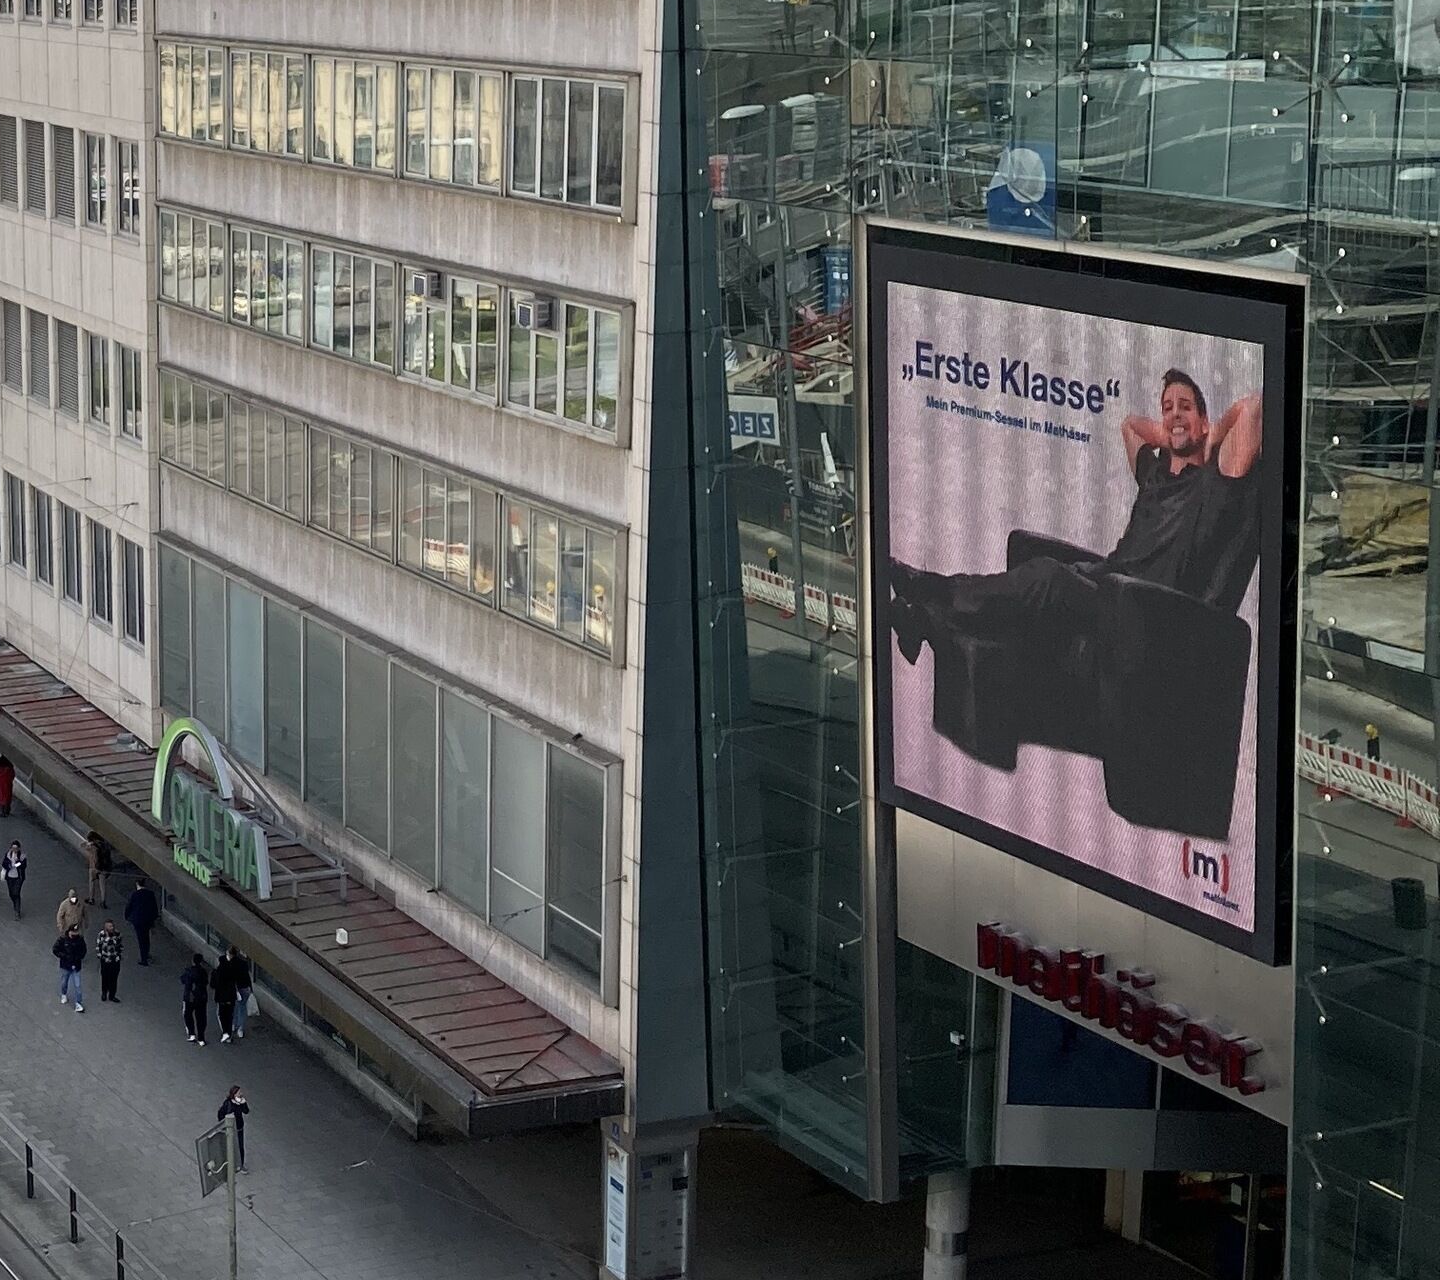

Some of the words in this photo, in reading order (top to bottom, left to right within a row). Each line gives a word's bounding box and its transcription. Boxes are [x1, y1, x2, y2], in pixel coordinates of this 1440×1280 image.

[926, 395, 948, 412] Mein
[950, 403, 1027, 429] Premium-Sessel
[1030, 417, 1042, 433] im
[1044, 420, 1091, 443] Mathäser
[171, 773, 271, 901] GALERIA
